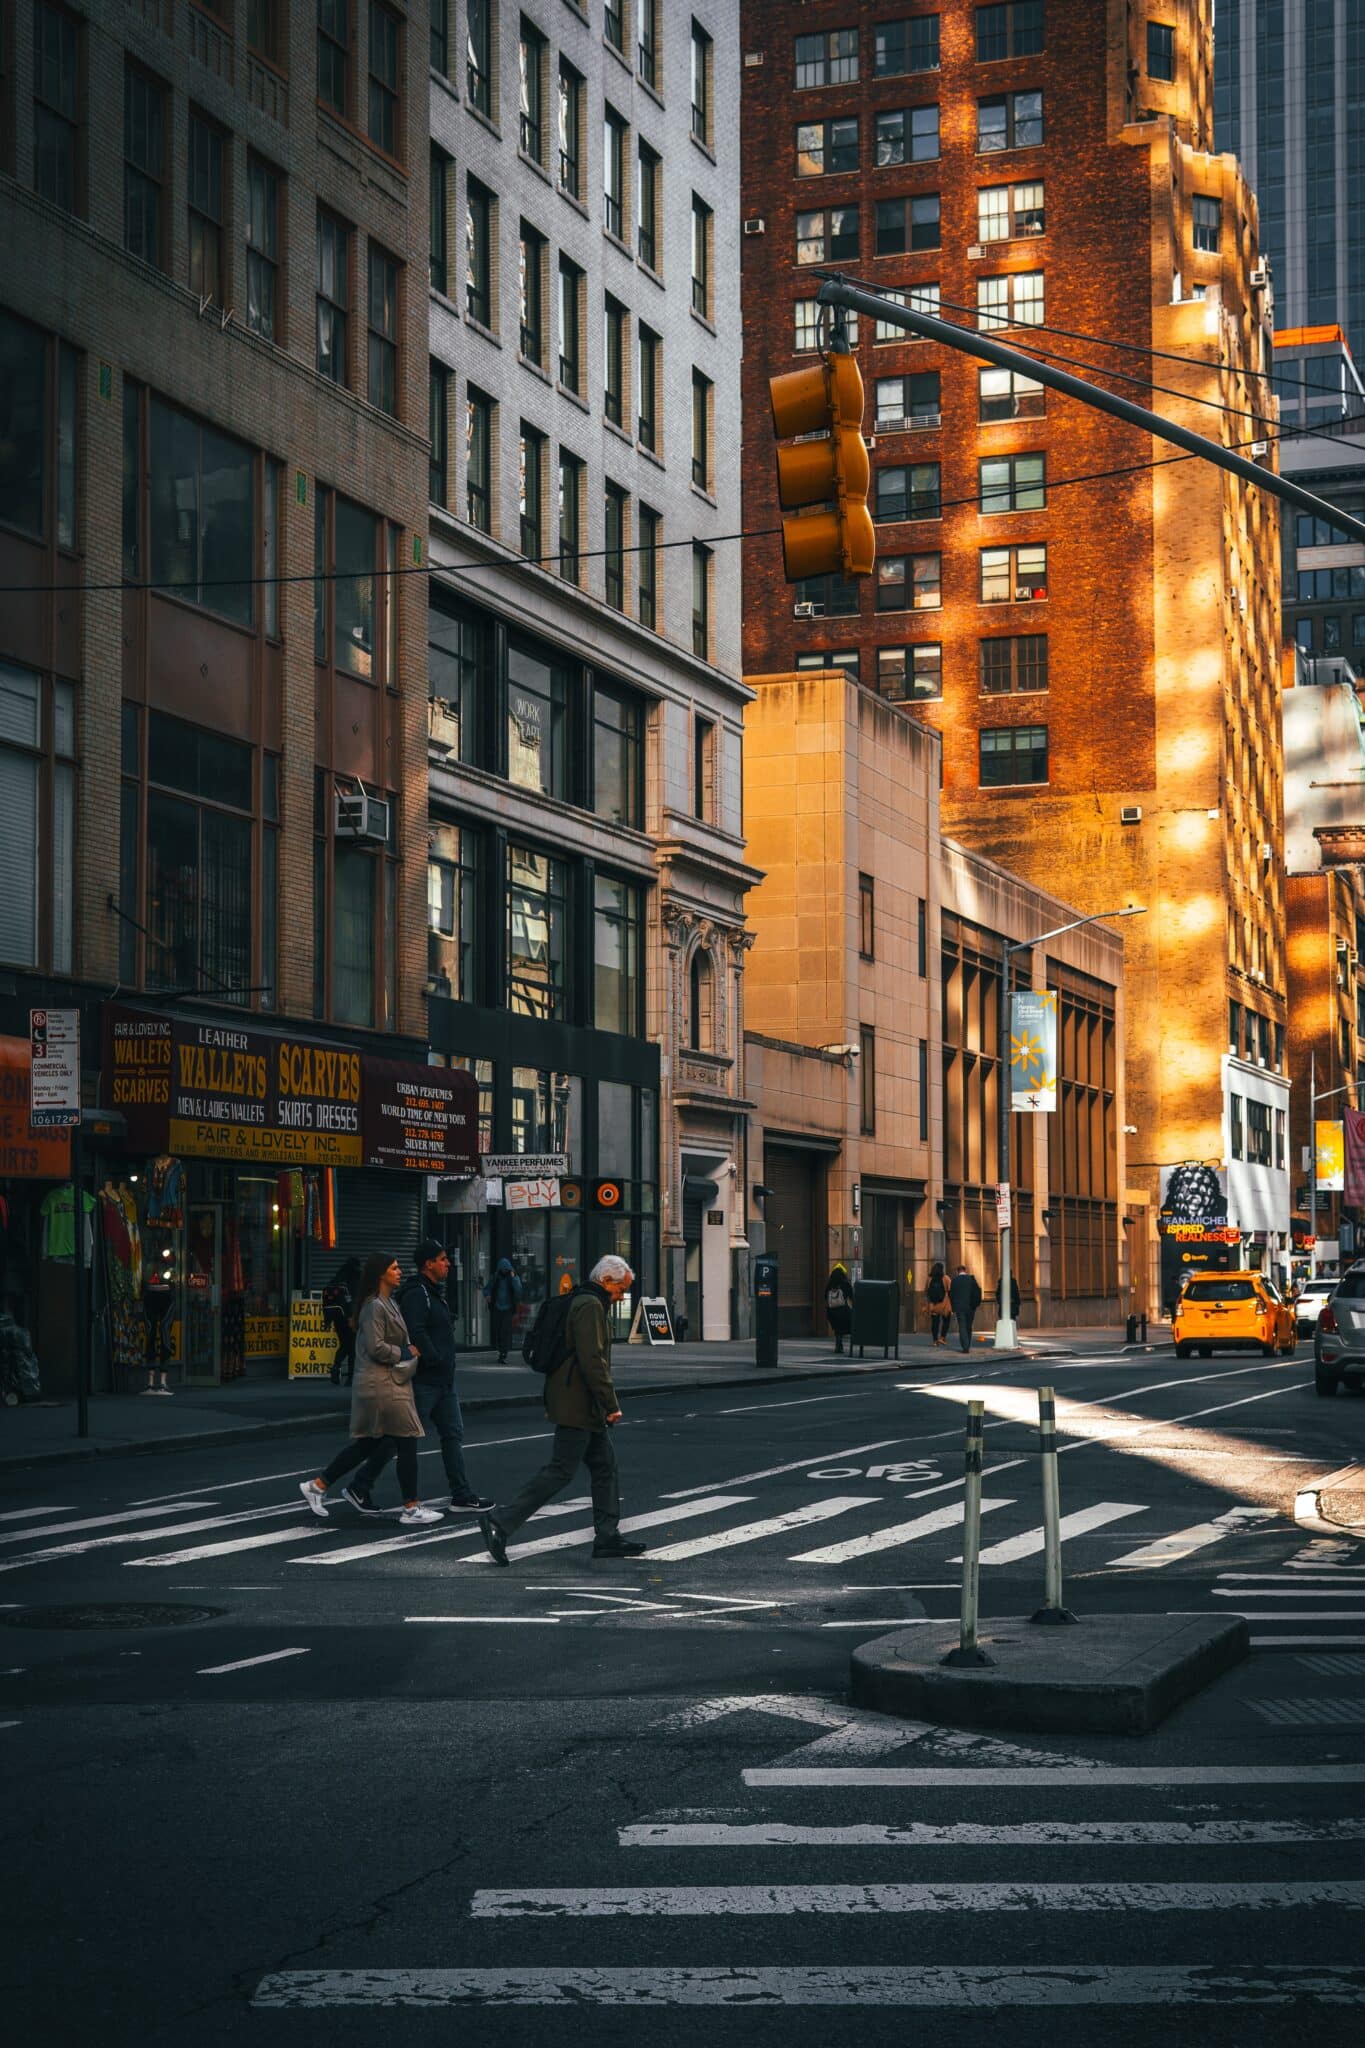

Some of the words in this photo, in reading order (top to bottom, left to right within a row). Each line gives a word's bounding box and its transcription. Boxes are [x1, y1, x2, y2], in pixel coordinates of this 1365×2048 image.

[517, 698, 541, 722] WORK
[114, 1023, 128, 1036] FAIR
[135, 1023, 159, 1036] LOVELY
[198, 1028, 248, 1050] LEATHER
[35, 1044, 43, 1057] 3
[114, 1039, 172, 1065] WALLETS
[178, 1044, 267, 1100] WALLETS
[279, 1042, 360, 1104] SCARVES
[113, 1078, 169, 1104] SCARVES
[396, 1082, 419, 1096] URBAN
[419, 1086, 453, 1101] PERFUMES
[177, 1096, 195, 1117] MEN
[195, 1098, 202, 1117] &
[203, 1099, 230, 1120] LADIES
[230, 1101, 265, 1123] WALLETS
[278, 1100, 312, 1127] SKIRTS
[316, 1104, 358, 1131] DRESSES
[381, 1103, 406, 1118] WORLD
[407, 1107, 423, 1120] TIME
[423, 1110, 433, 1121] OF
[434, 1111, 448, 1123] NEW
[448, 1113, 466, 1125] YORK
[196, 1125, 230, 1145] FAIR
[235, 1130, 247, 1145] &
[252, 1131, 310, 1150] LOVELY
[314, 1135, 341, 1153] INC.
[404, 1138, 428, 1151] SILVER
[428, 1140, 445, 1153] MINE
[486, 1158, 518, 1167] YANKEE
[519, 1157, 564, 1167] PERFUMES
[1175, 1232, 1226, 1242] REALNESS
[762, 1266, 770, 1278] P
[291, 1336, 338, 1348] SCARVES
[309, 1350, 316, 1361] &
[295, 1362, 333, 1374] SKIRTS
